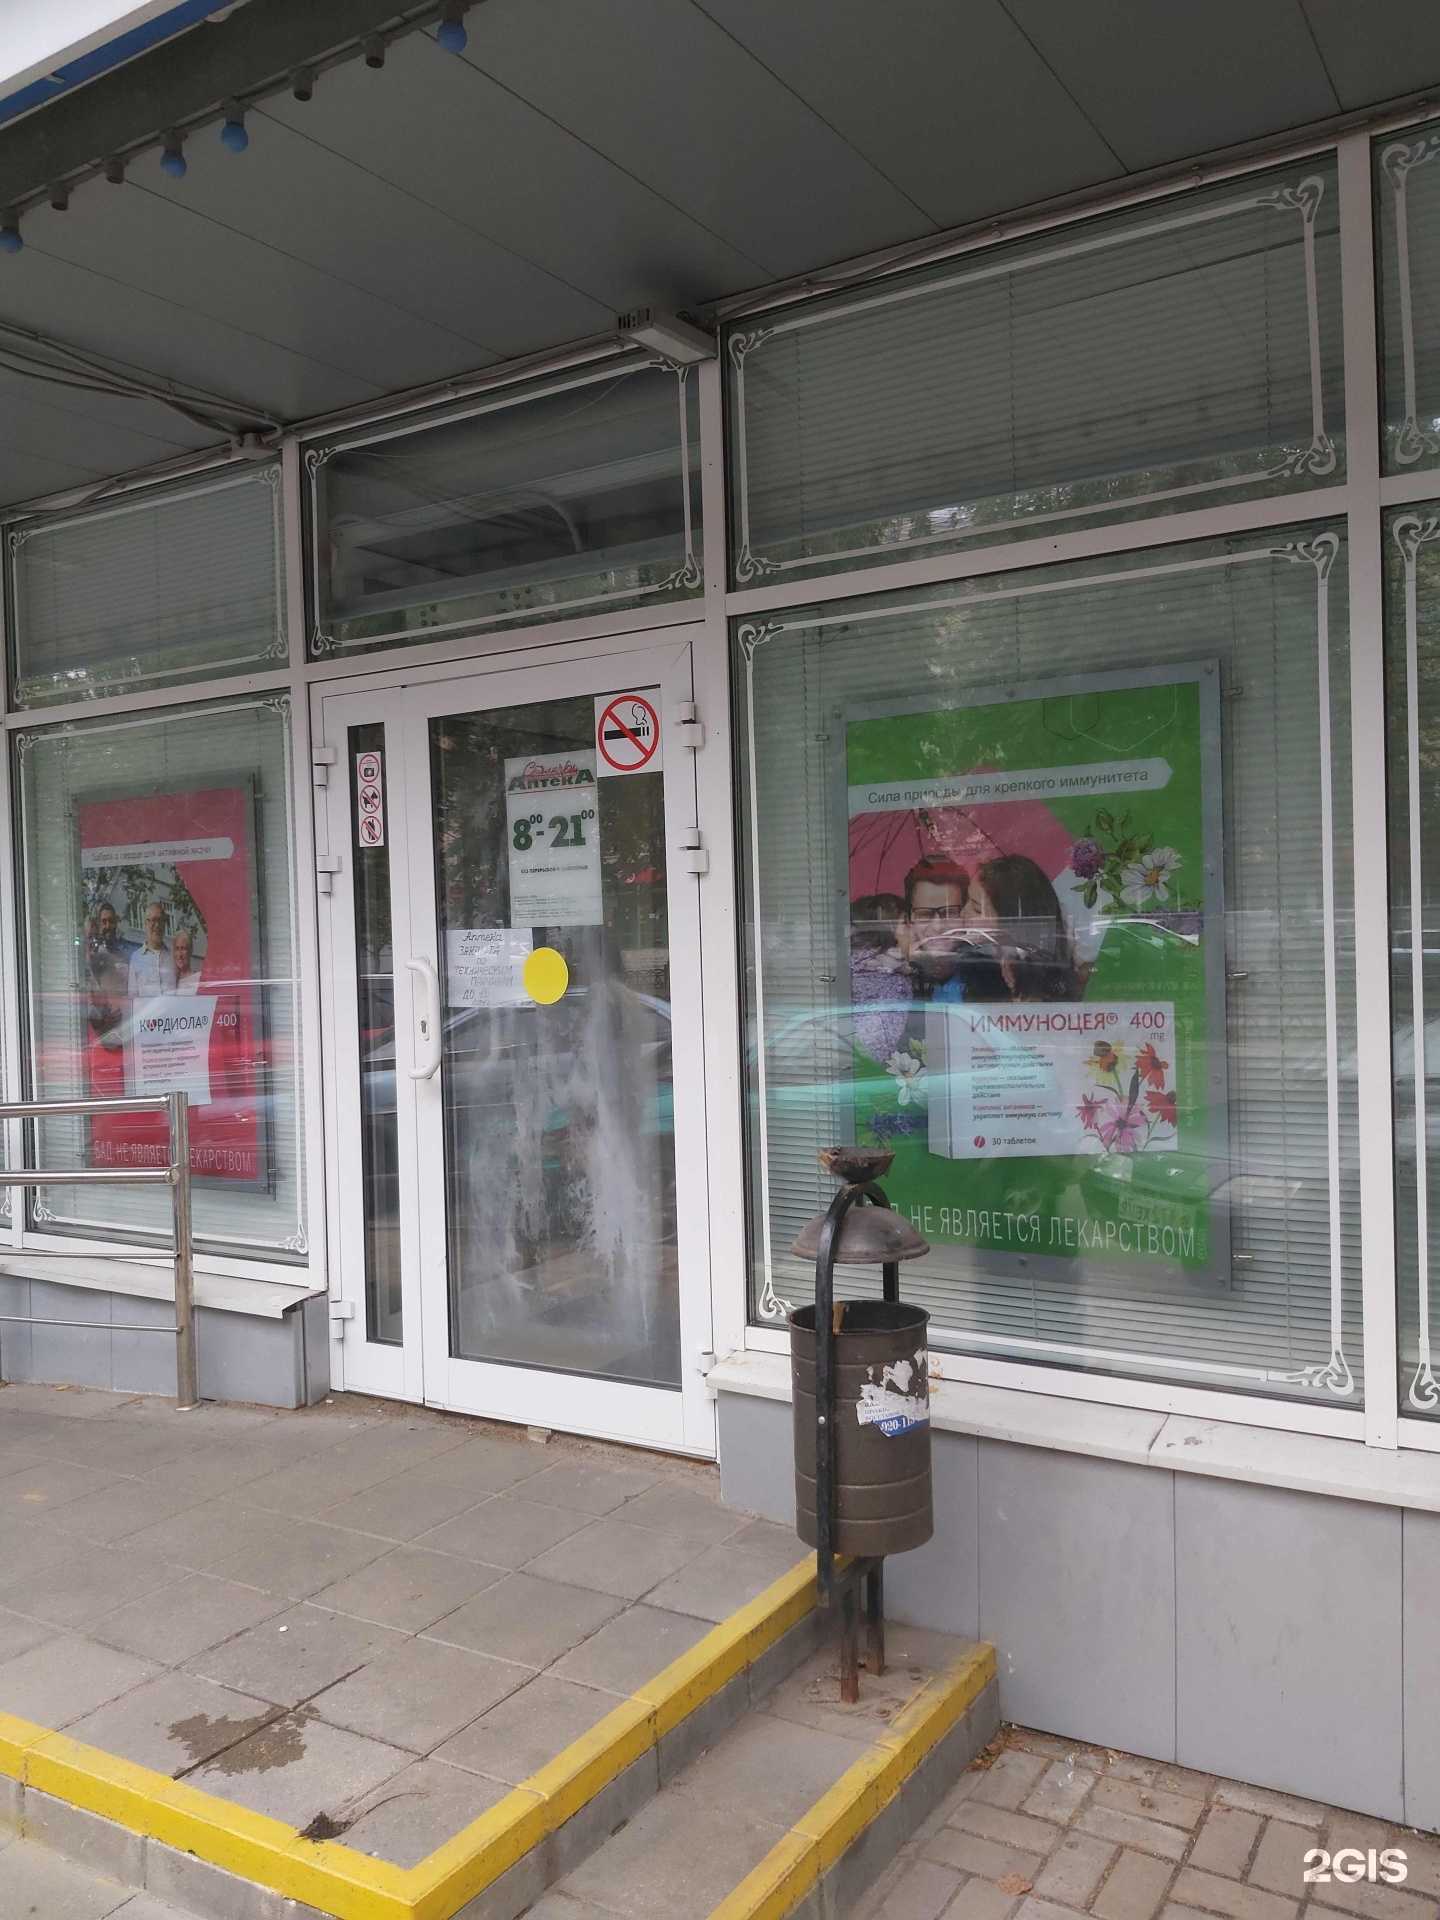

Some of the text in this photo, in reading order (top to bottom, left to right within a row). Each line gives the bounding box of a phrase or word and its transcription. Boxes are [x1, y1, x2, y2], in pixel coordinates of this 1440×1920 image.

[868, 791, 900, 804] Сила
[965, 784, 990, 797] для
[994, 777, 1055, 795] крепкого
[1060, 769, 1149, 790] иммунитета
[216, 1013, 237, 1027] 400
[970, 1011, 1165, 1034] ИММУНОЦЕЯ® 400
[992, 1136, 1036, 1146] 30 таблеток
[130, 1143, 170, 1165] ЯВЛЯЕТ
[190, 1147, 256, 1172] ЕКАРСТВОМ
[910, 1205, 934, 1233] НЕ
[939, 1207, 1041, 1243] ЯВЛЯЕТСЯ
[1048, 1216, 1195, 1257] ЛЕКАРСТВОМ
